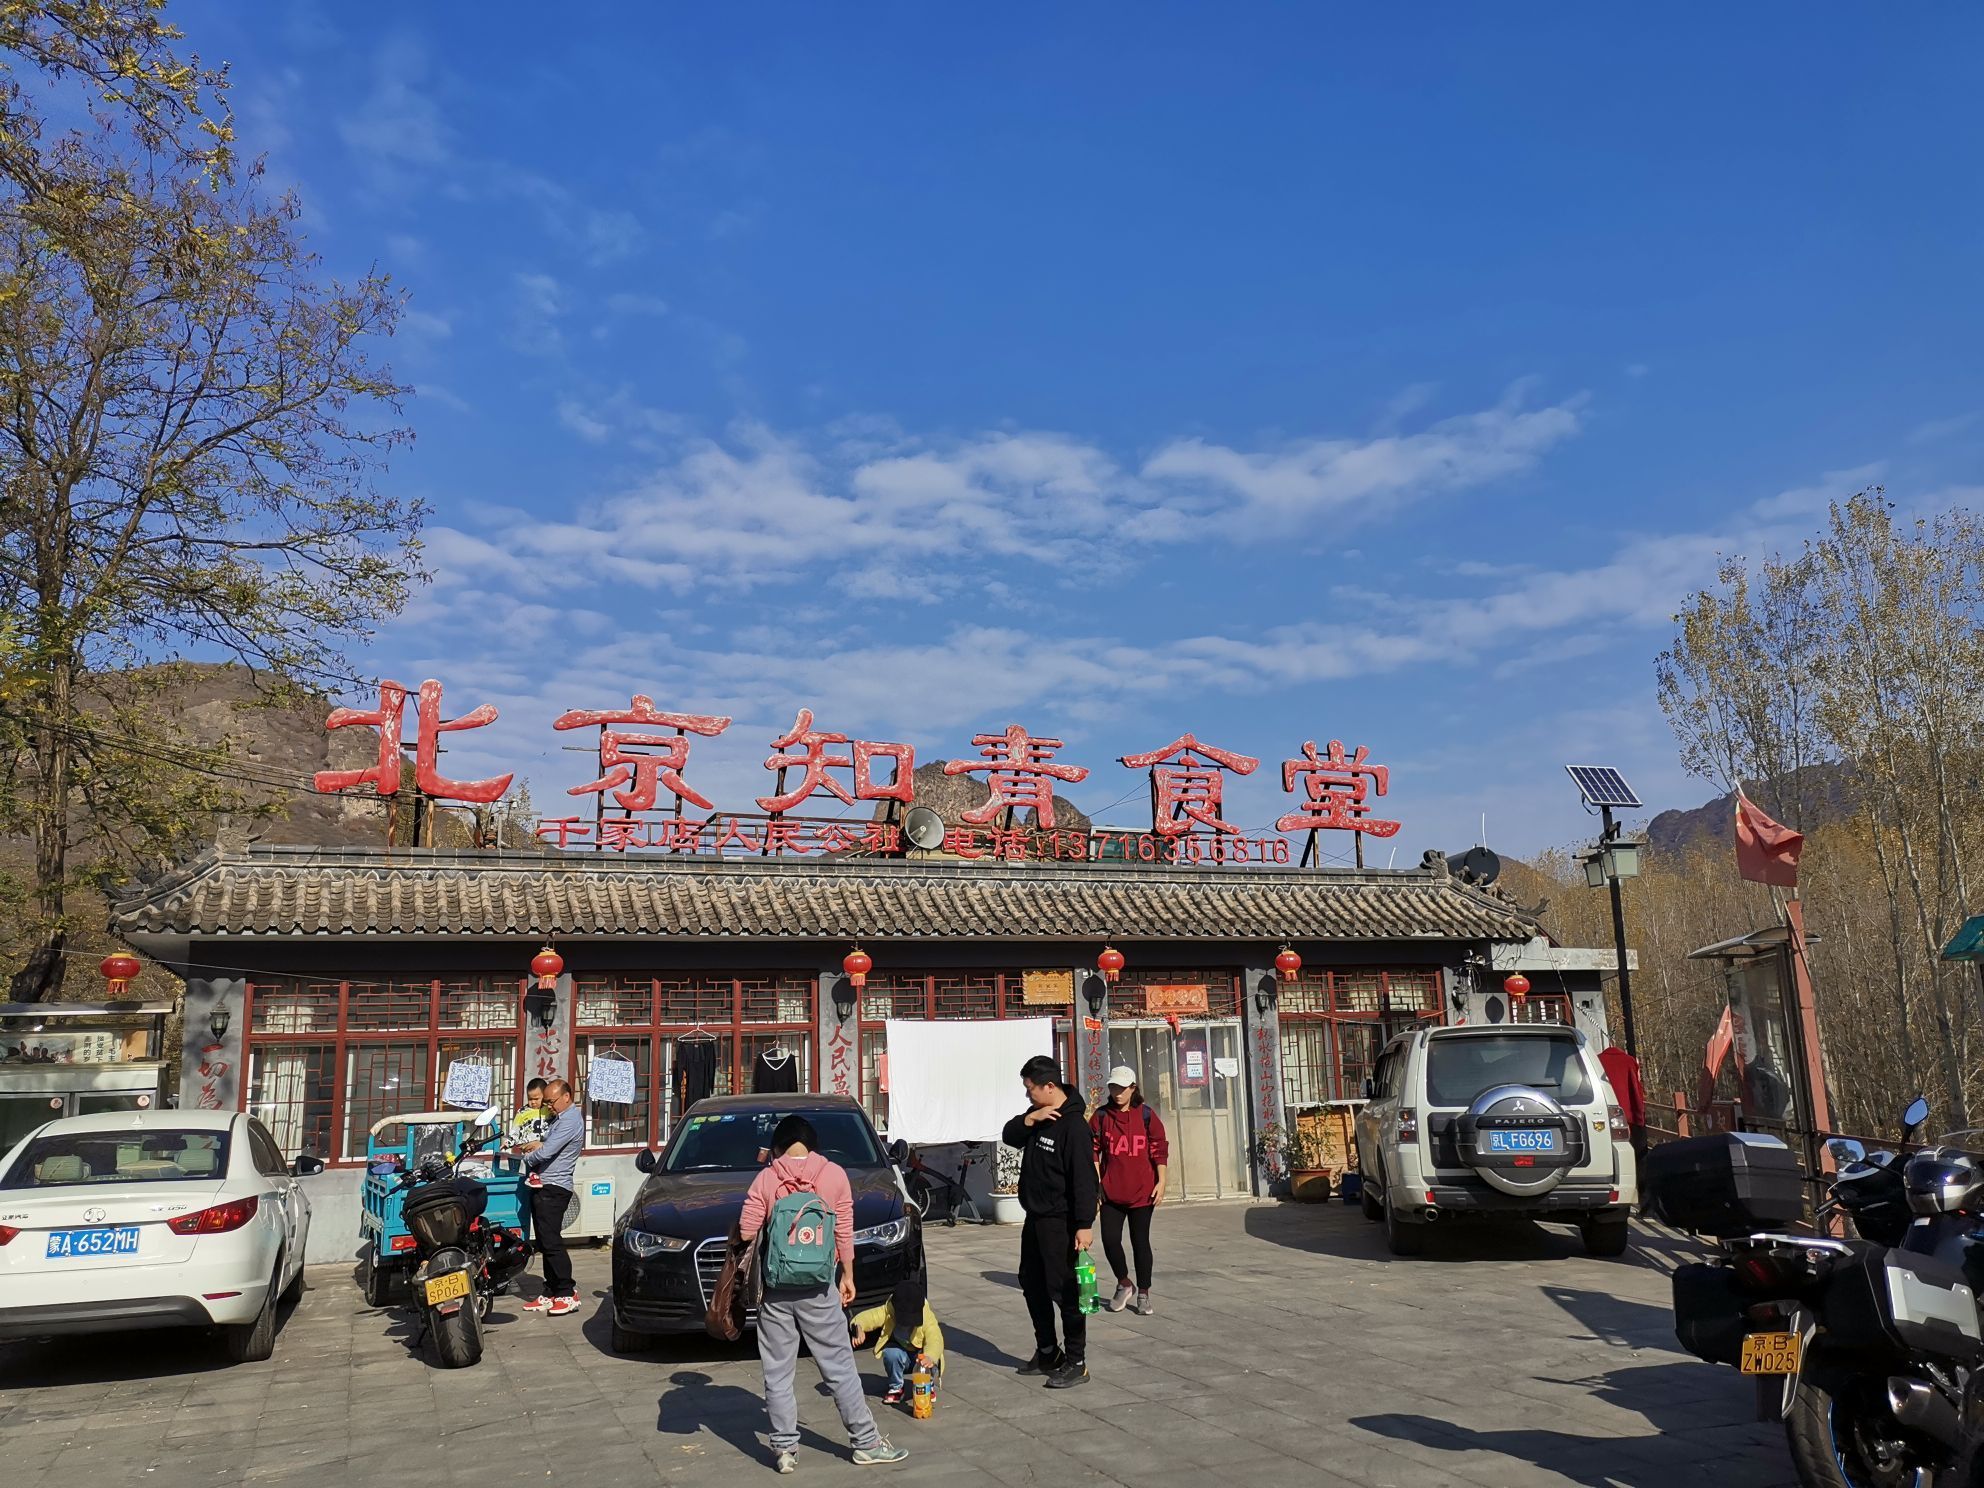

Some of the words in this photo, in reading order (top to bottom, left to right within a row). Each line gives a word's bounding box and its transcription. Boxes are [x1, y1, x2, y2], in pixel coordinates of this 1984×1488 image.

[313, 678, 1401, 838] 北京知青食堂
[536, 816, 901, 853] 千家店人民公社
[429, 1282, 465, 1302] SP061
[1743, 1351, 1795, 1371] ZW025
